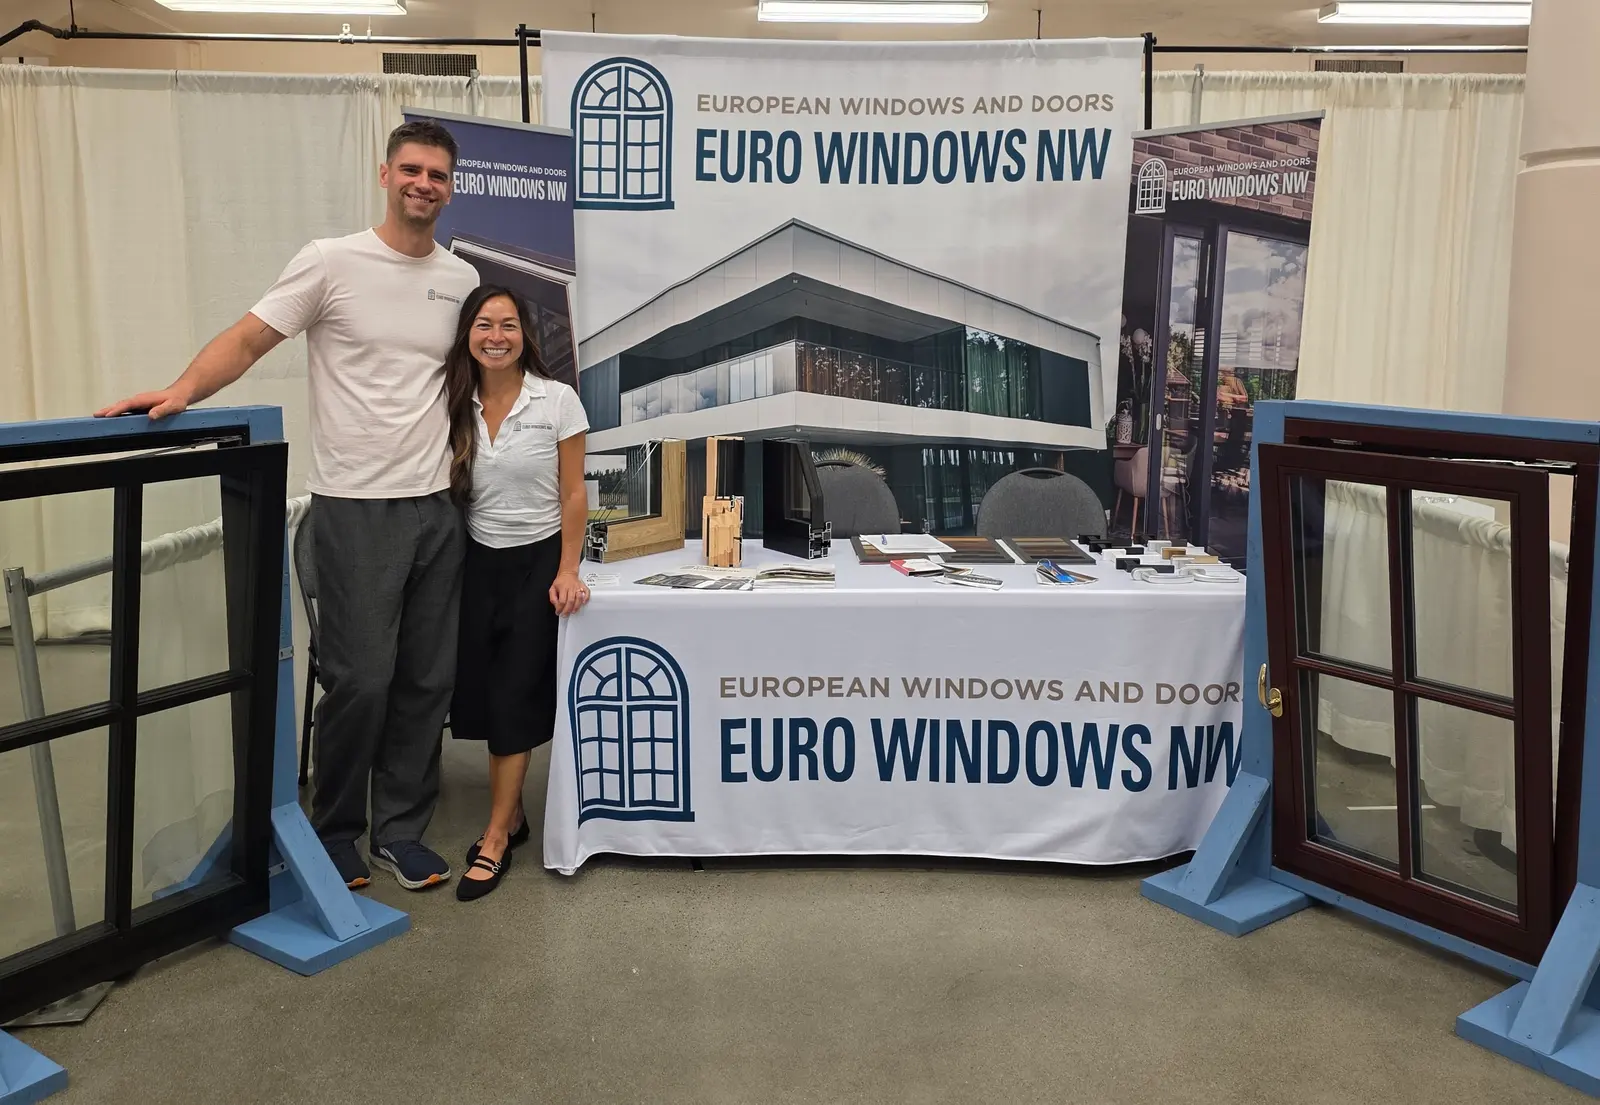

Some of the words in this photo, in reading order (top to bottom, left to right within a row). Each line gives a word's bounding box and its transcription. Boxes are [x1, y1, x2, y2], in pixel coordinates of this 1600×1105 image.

[696, 93, 832, 116] EUROPEAN
[838, 96, 966, 117] WINDOWS
[972, 94, 1024, 114] AND
[1031, 92, 1114, 113] DOORS
[456, 159, 491, 169] UROPEAN
[493, 162, 528, 172] WINDOWS
[529, 166, 543, 175] AND
[544, 168, 567, 177] DOORS
[695, 127, 802, 183] EURO
[814, 127, 1027, 186] WINDOWS
[1035, 127, 1113, 183] NW
[1173, 166, 1215, 176] EUROPEAN
[1217, 162, 1257, 172] WINDOWS
[1260, 159, 1278, 168] AND
[1280, 157, 1311, 166] DOORS
[453, 171, 485, 195] EURO
[487, 175, 545, 200] WINDOWS
[547, 181, 567, 202] NW
[1171, 179, 1205, 201] EURO
[1208, 174, 1278, 198] WINDOWS
[1282, 171, 1309, 195] NW
[720, 676, 890, 699] EUROPEAN
[901, 677, 1064, 701] WINDOWS
[1075, 680, 1144, 704] AND
[1155, 682, 1242, 706] DOOR
[720, 717, 856, 783] EURO
[870, 718, 1152, 793] WINDOWS
[1168, 721, 1243, 791] NW
